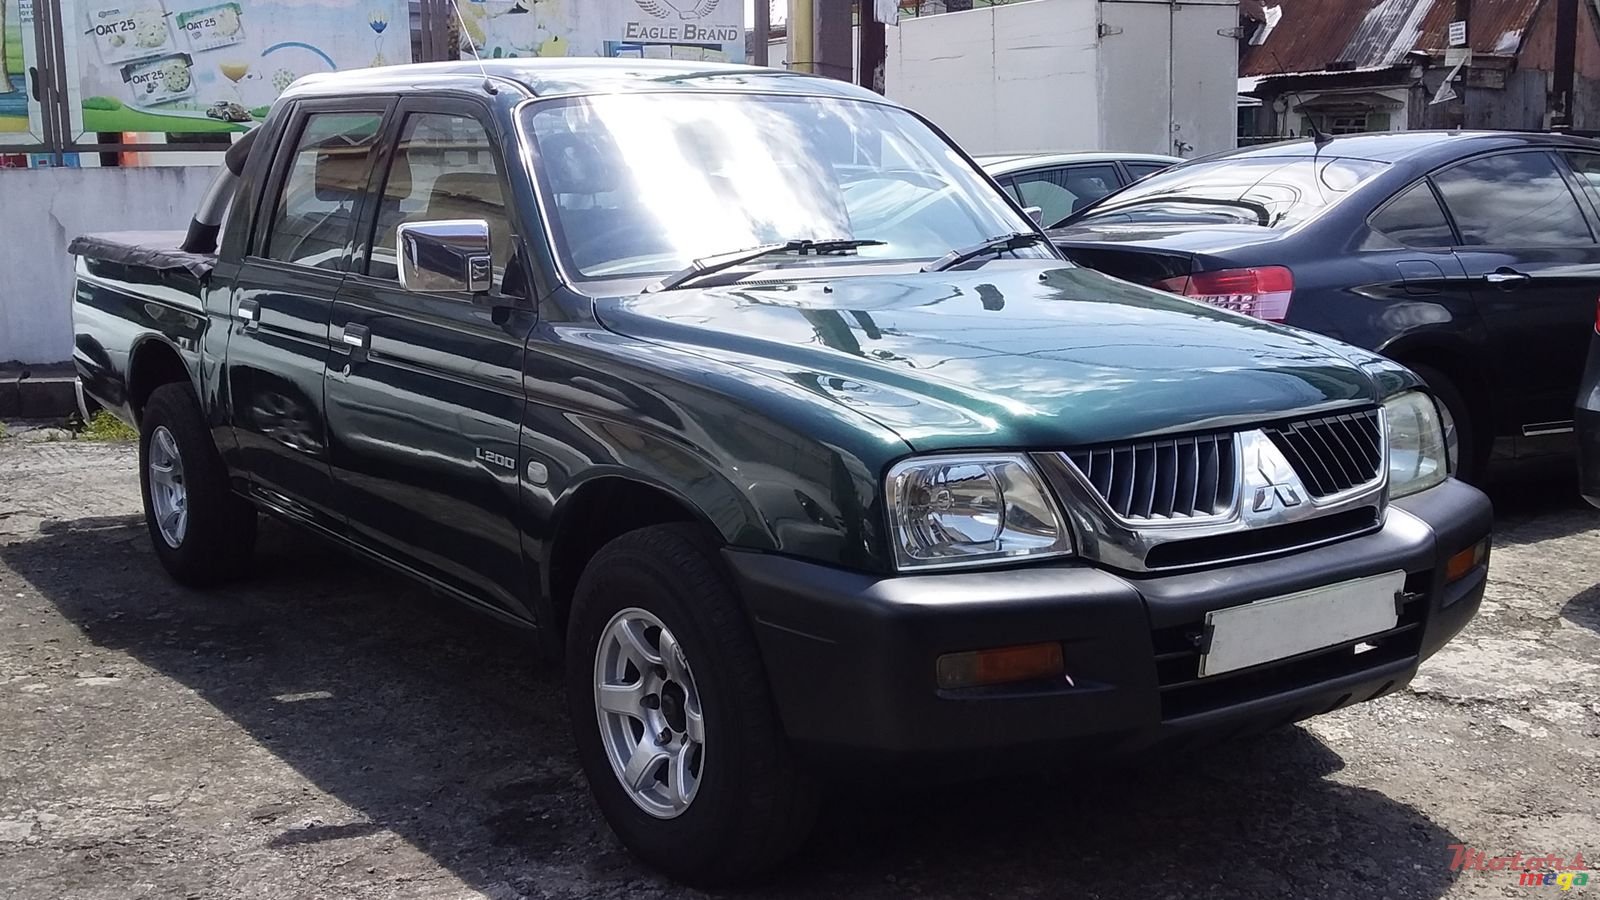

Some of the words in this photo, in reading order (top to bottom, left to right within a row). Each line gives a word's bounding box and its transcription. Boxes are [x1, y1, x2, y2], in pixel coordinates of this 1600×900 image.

[96, 23, 118, 35] OAT
[120, 19, 136, 31] 25
[187, 21, 203, 31] OAT
[204, 18, 216, 27] 25
[626, 22, 678, 39] EAGLE
[683, 24, 737, 41] BRAND
[132, 74, 150, 84] OAT
[151, 70, 164, 80] 25
[475, 447, 516, 469] L200
